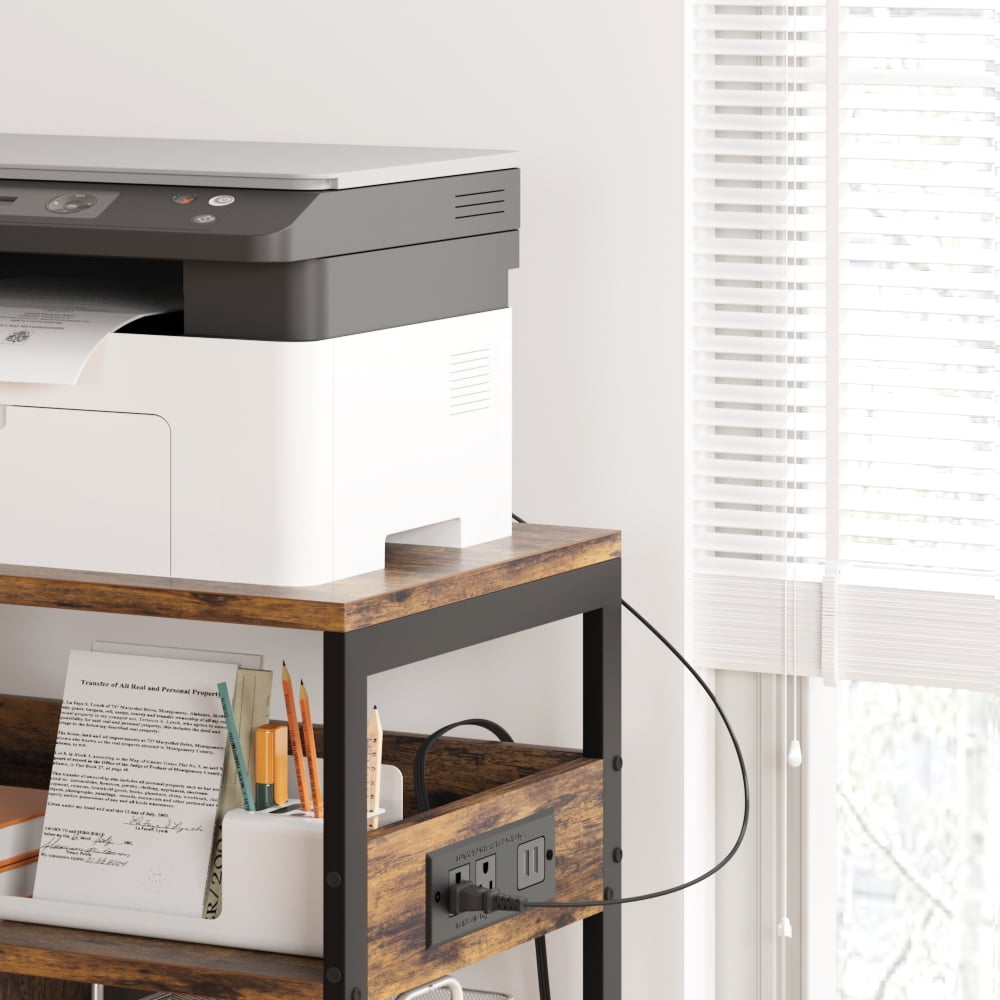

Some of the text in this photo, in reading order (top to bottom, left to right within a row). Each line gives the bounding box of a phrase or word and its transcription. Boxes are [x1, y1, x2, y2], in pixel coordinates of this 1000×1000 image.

[80, 679, 110, 687] Transfer
[131, 683, 147, 691] Real
[161, 686, 191, 695] Personal
